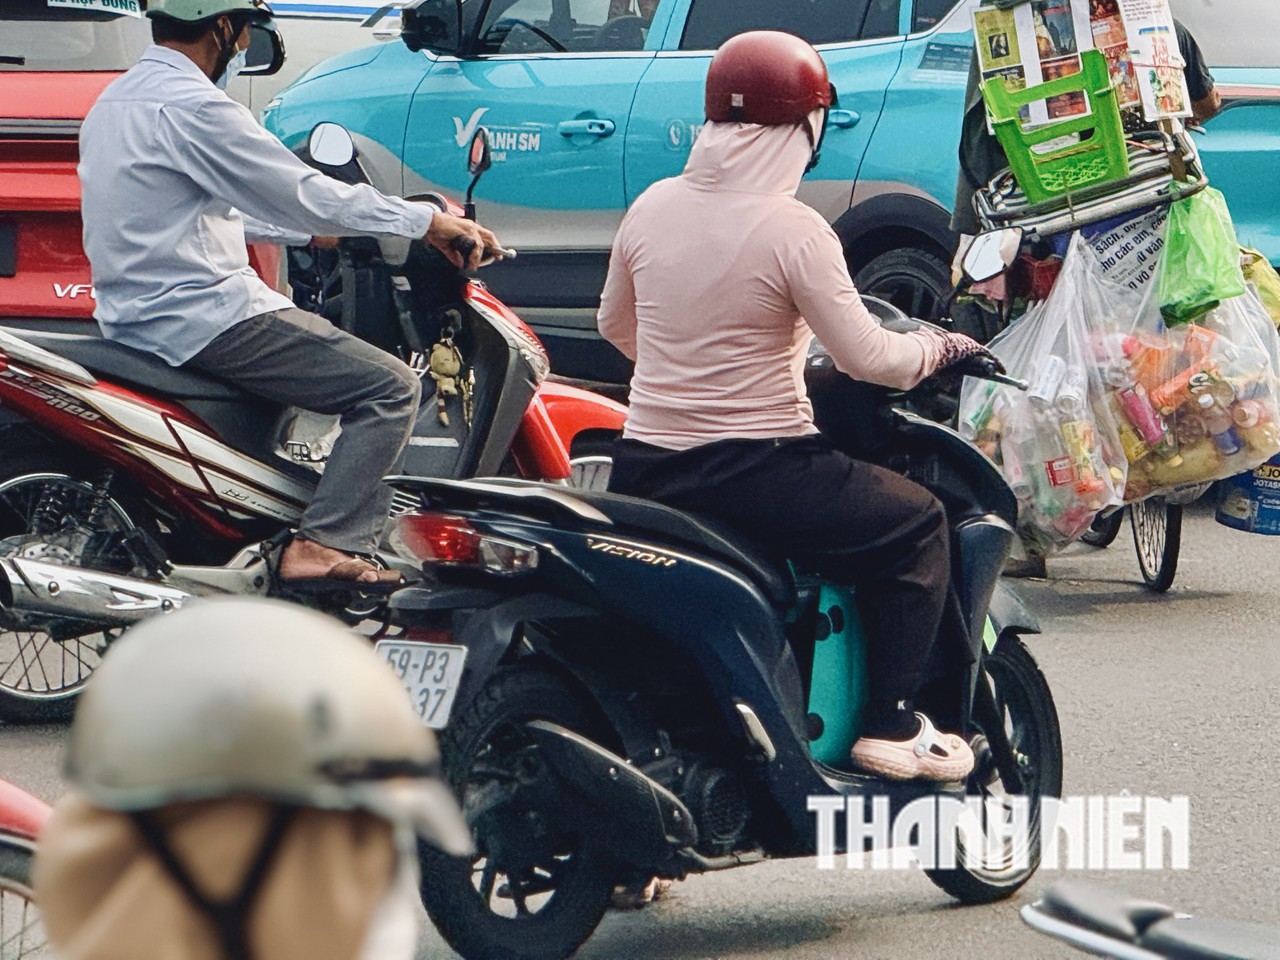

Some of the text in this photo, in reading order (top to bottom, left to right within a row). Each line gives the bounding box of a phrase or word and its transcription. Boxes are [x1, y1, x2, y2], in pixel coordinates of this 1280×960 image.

[518, 132, 541, 151] SM
[1114, 241, 1135, 261] các
[587, 538, 677, 567] VISION
